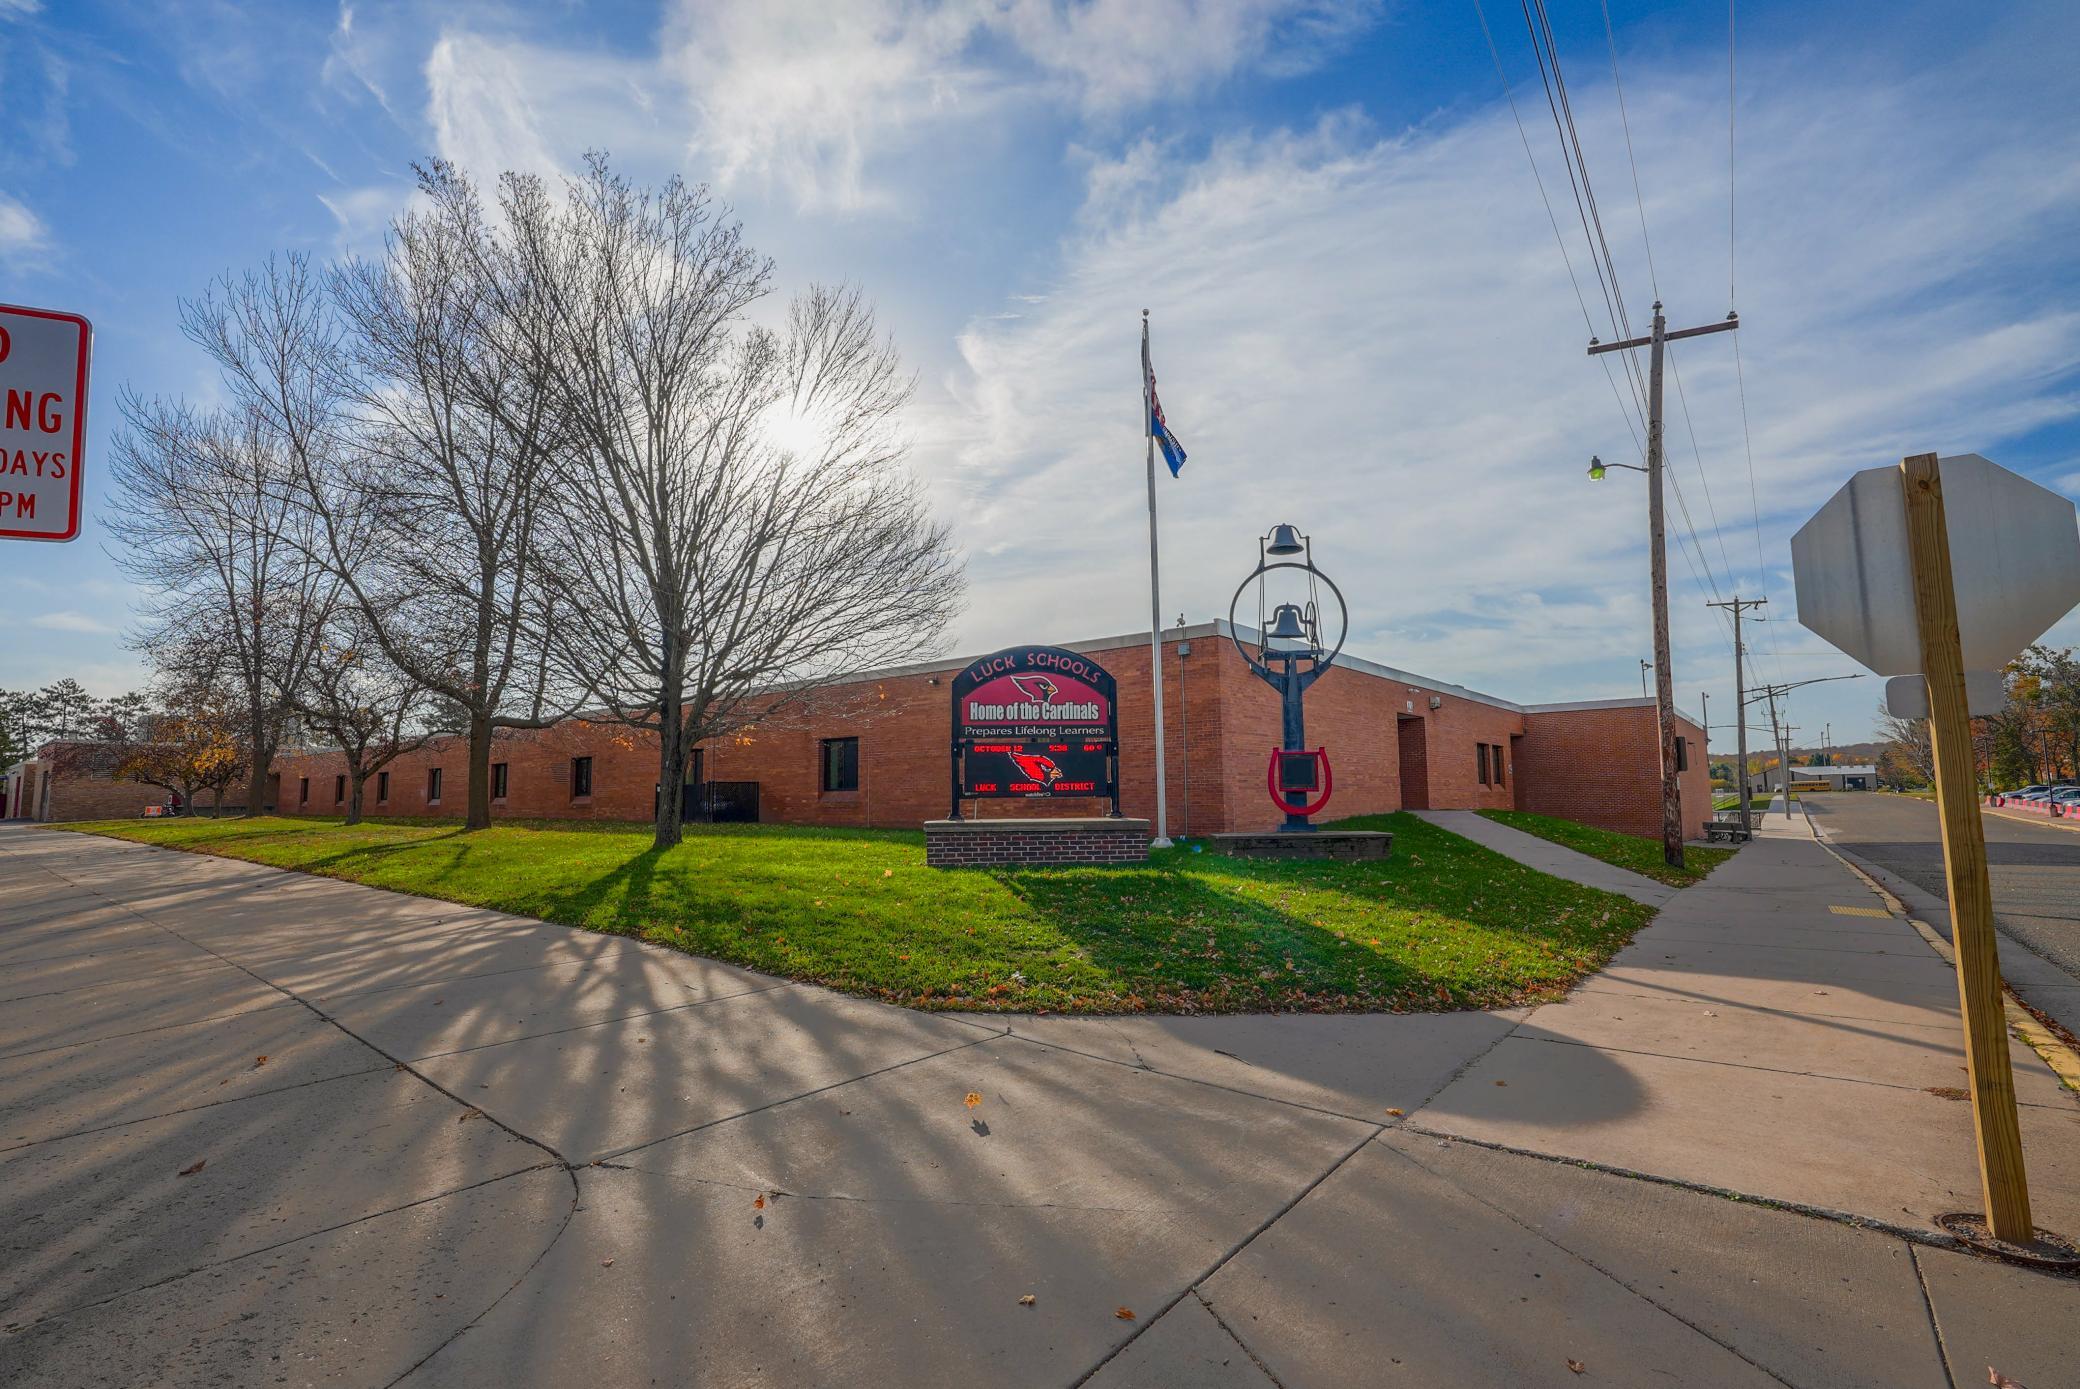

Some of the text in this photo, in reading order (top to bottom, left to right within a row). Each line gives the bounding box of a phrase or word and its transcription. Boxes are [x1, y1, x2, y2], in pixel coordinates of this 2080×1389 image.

[0, 491, 36, 519] PM
[971, 653, 1102, 683] LUCK SCHOOLS
[970, 702, 1099, 721] Home of the Cardinals
[965, 726, 1105, 737] Prepares Lifelong Learners
[975, 782, 1095, 792] LUCK SCHOOL DISTRICT
